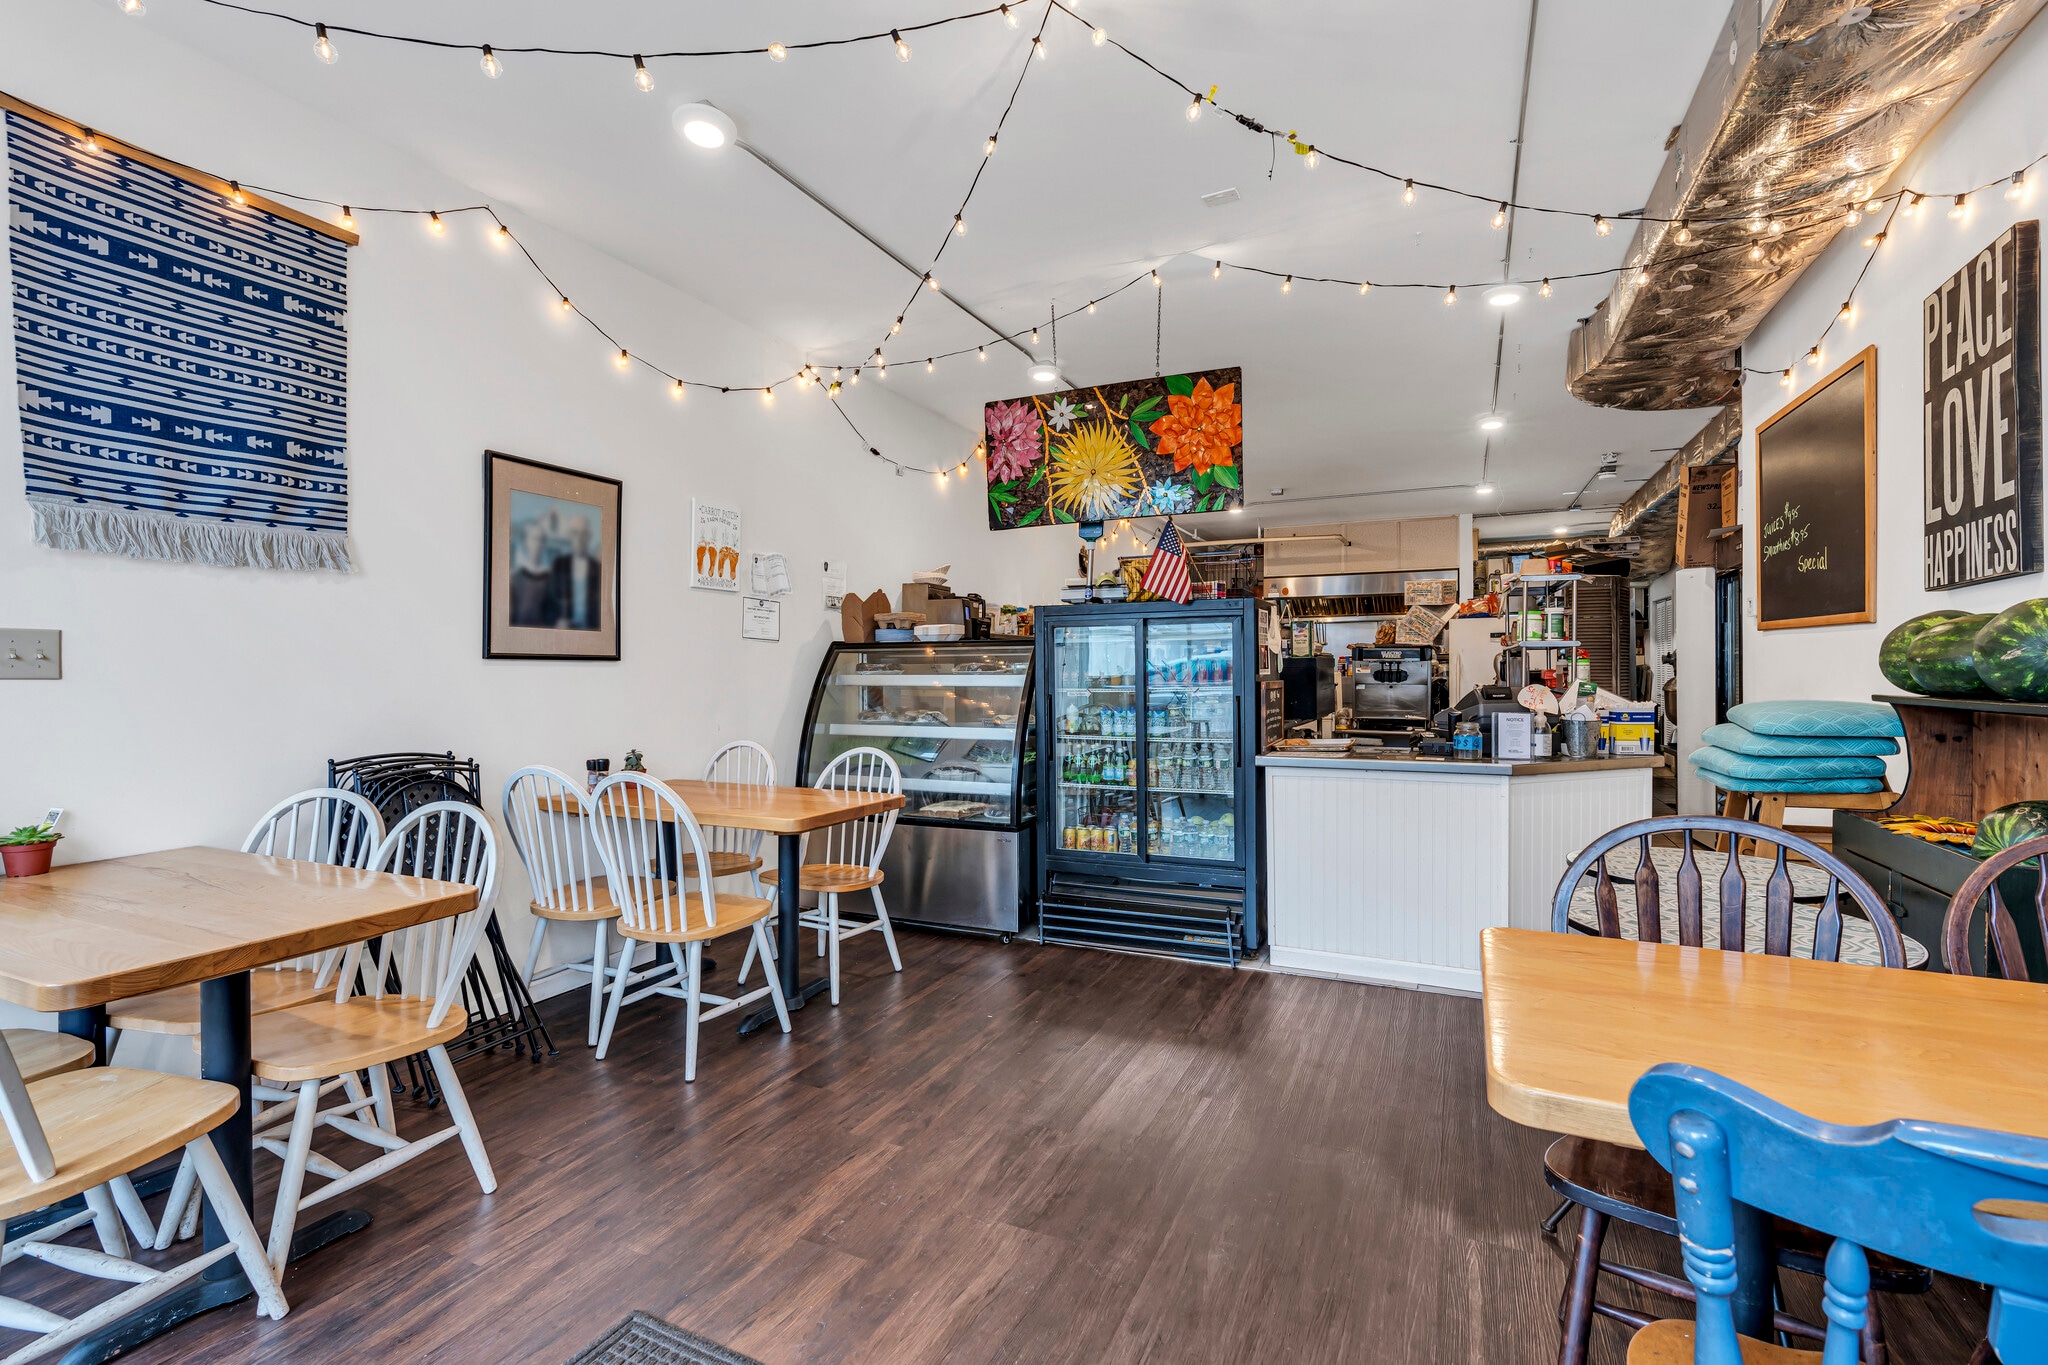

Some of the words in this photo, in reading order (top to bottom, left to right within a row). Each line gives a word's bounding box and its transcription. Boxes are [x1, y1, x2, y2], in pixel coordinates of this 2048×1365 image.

[1924, 228, 2013, 393] PEACE
[1925, 353, 2016, 525] LOVE
[1797, 546, 1828, 573] Special
[1924, 509, 2018, 589] HAPPINESS
